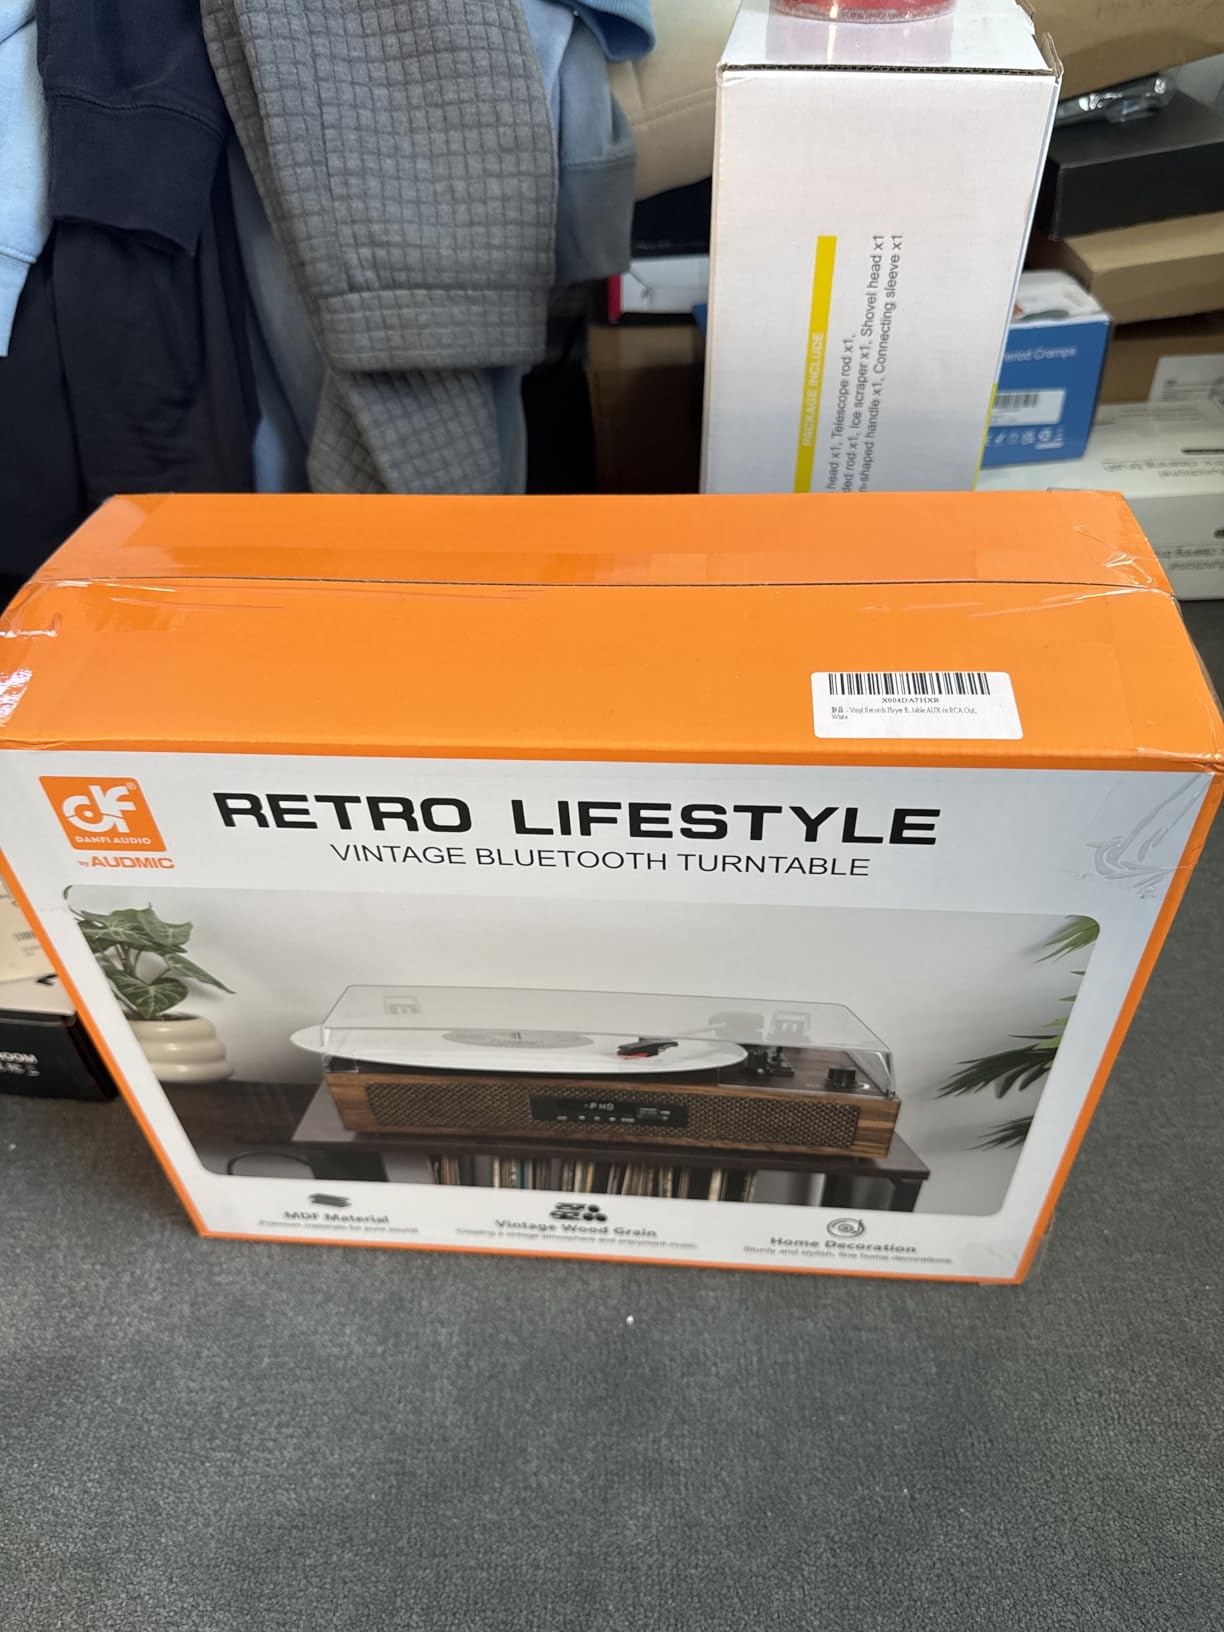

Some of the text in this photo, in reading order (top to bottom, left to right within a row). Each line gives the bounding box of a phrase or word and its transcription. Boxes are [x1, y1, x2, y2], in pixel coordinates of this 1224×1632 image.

[872, 234, 885, 251] x1
[891, 235, 903, 251] x1
[867, 255, 882, 289] head
[883, 254, 900, 299] sleeve
[860, 292, 878, 337] Shovel
[873, 300, 897, 374] Connecting
[840, 356, 852, 377] rod
[1003, 351, 1031, 362] eriod
[800, 332, 825, 448] PACKAGE INCLUDE
[854, 362, 869, 409] scraper
[831, 380, 850, 439] Telescope
[850, 411, 862, 429] Ice
[864, 398, 881, 439] handle
[845, 452, 857, 471] rod
[825, 461, 840, 490] head
[864, 706, 886, 714] Records
[949, 706, 963, 714] RCA
[212, 792, 942, 846] RETRO LIFESTYLE
[113, 836, 152, 845] AUDIO
[91, 856, 176, 869] AUDMIC
[330, 844, 871, 877] VINTAGE BLUETOOTH TURNTABLE
[284, 1210, 390, 1224] MDF Material
[494, 1218, 657, 1238] Vintage Wood Grain
[770, 1236, 918, 1254] Home Decoration
